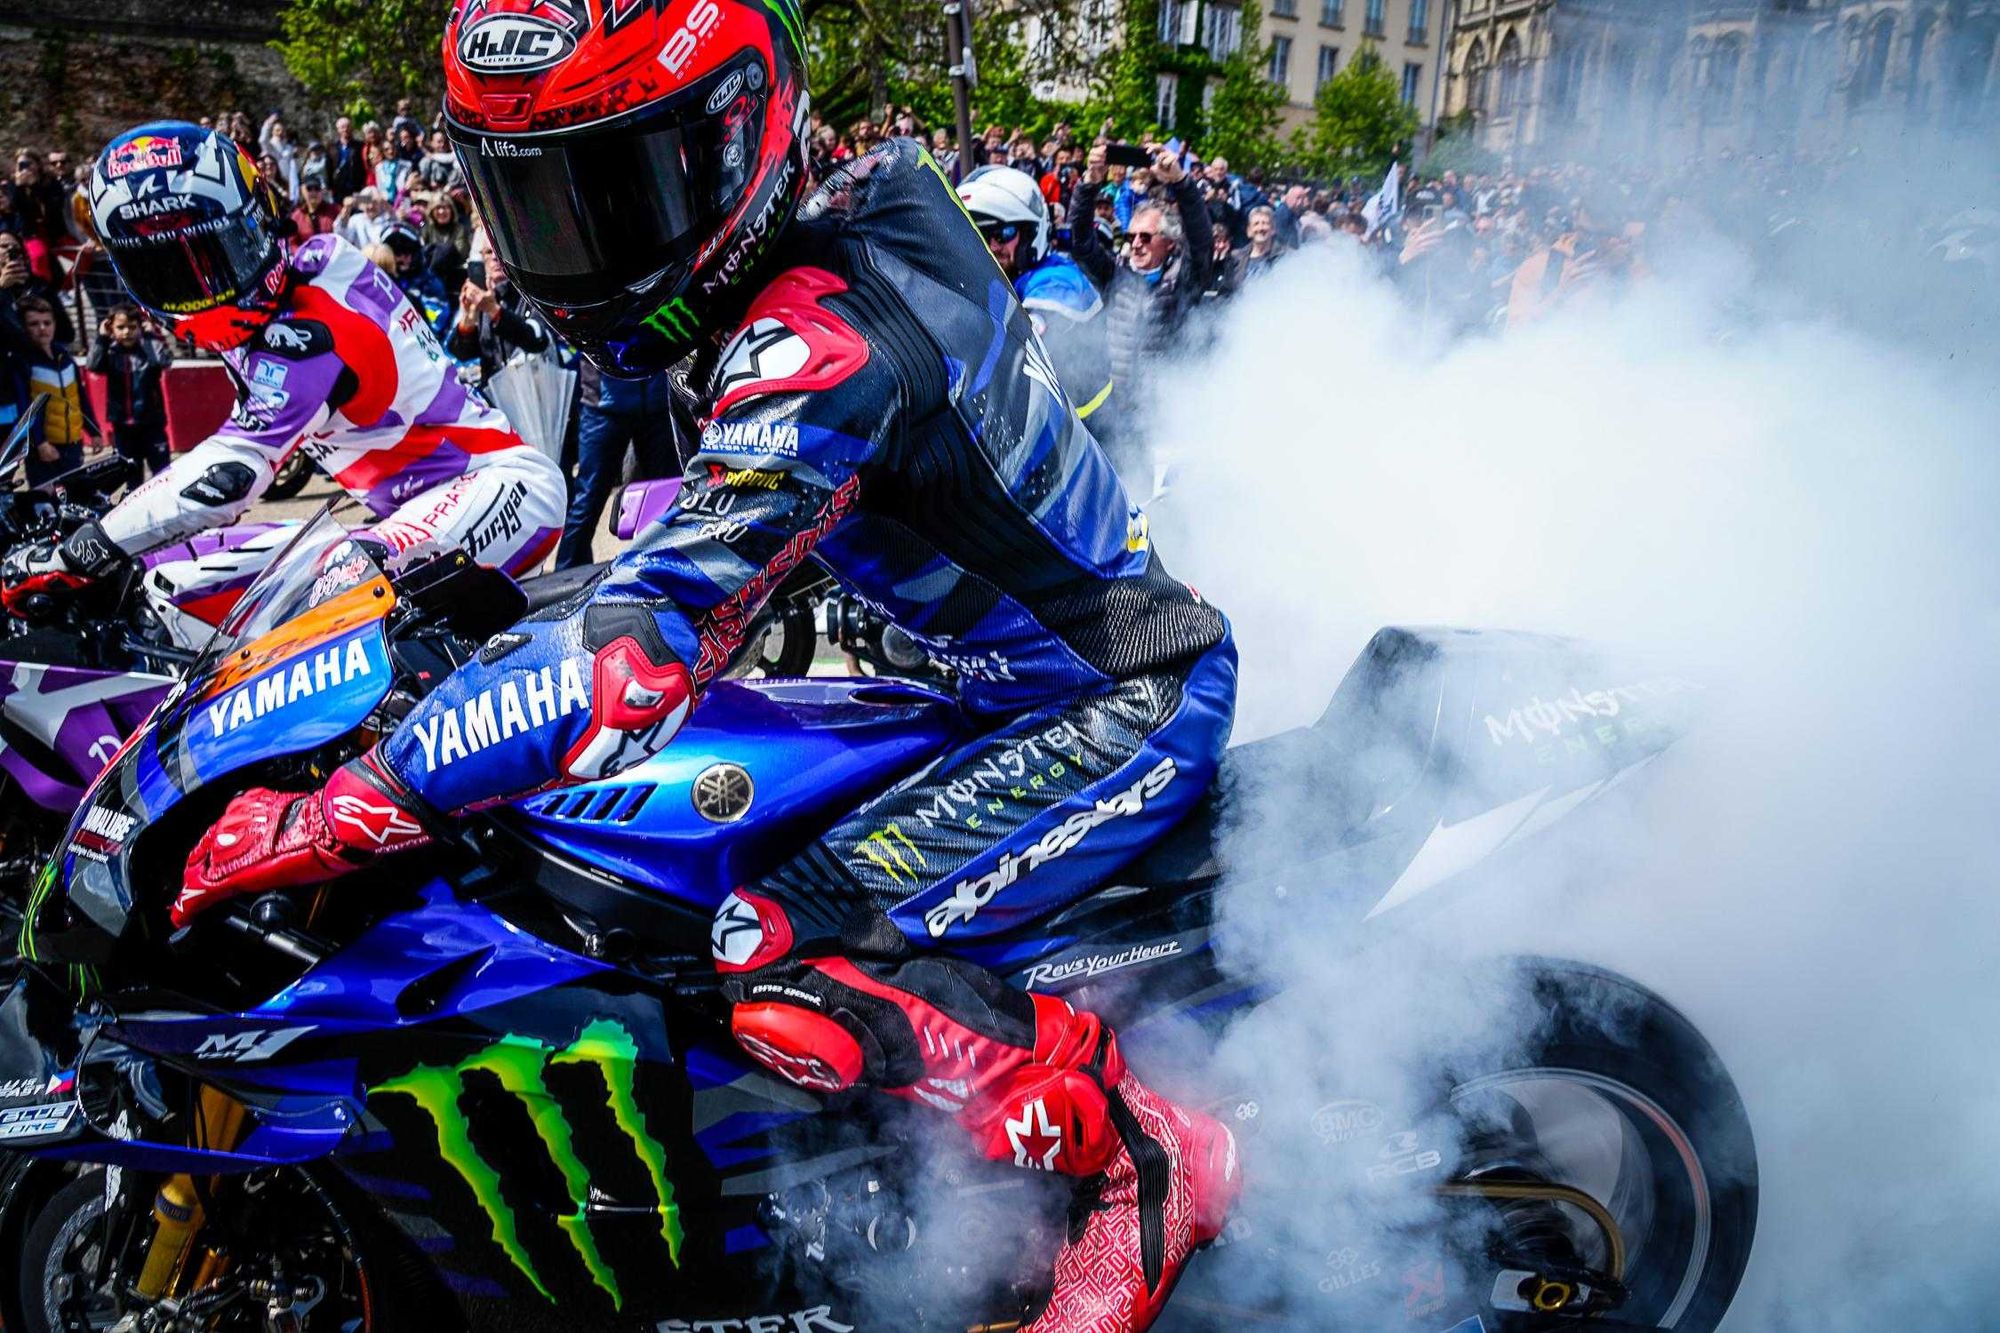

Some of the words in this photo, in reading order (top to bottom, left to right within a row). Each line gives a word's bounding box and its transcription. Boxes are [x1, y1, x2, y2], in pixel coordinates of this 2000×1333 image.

[467, 29, 556, 60] HJC
[656, 0, 719, 74] BS
[119, 193, 196, 220] SHARK
[147, 230, 176, 245] YOU
[182, 216, 230, 237] WINGS
[722, 422, 799, 451] YAMAHA
[754, 446, 797, 458] RACING
[208, 637, 371, 738] YAMAHA
[413, 656, 590, 773] YAMAHA
[924, 757, 1177, 938] alpinestars
[1128, 940, 1182, 968] Heart
[192, 1024, 320, 1062] M1
[1317, 1262, 1381, 1294] GILLES
